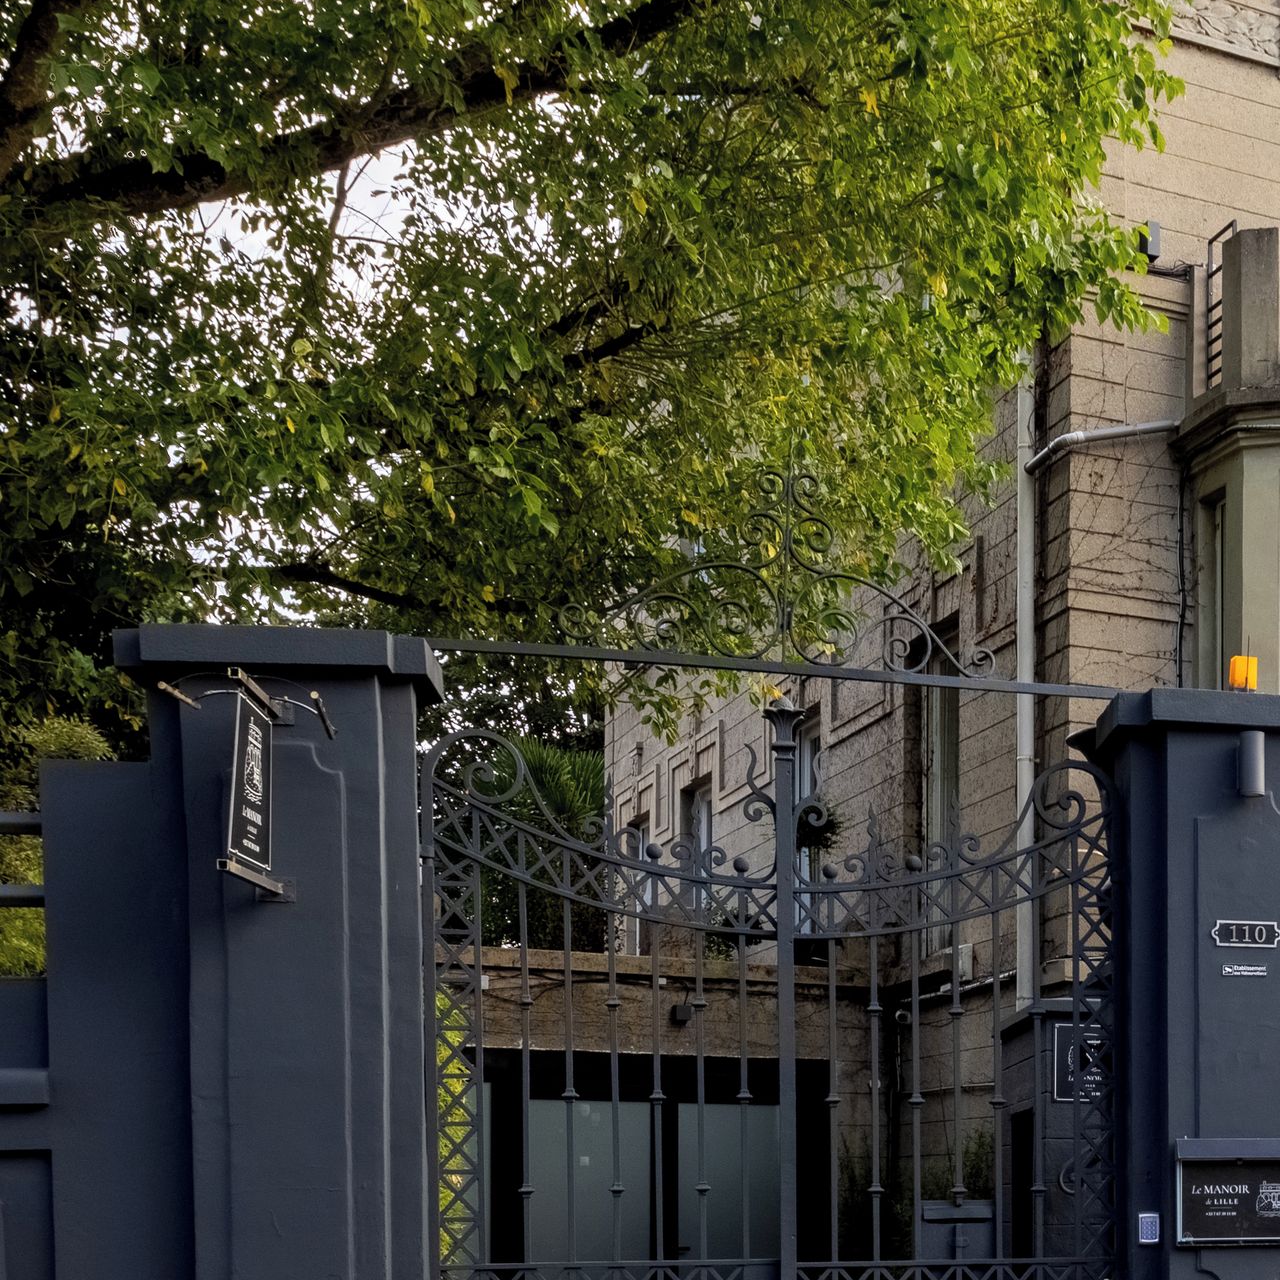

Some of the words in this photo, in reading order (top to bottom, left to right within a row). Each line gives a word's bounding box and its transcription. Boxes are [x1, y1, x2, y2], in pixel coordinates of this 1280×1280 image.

[1229, 925, 1267, 943] 110
[1191, 1185, 1202, 1195] Le
[1203, 1184, 1250, 1194] MANOIR
